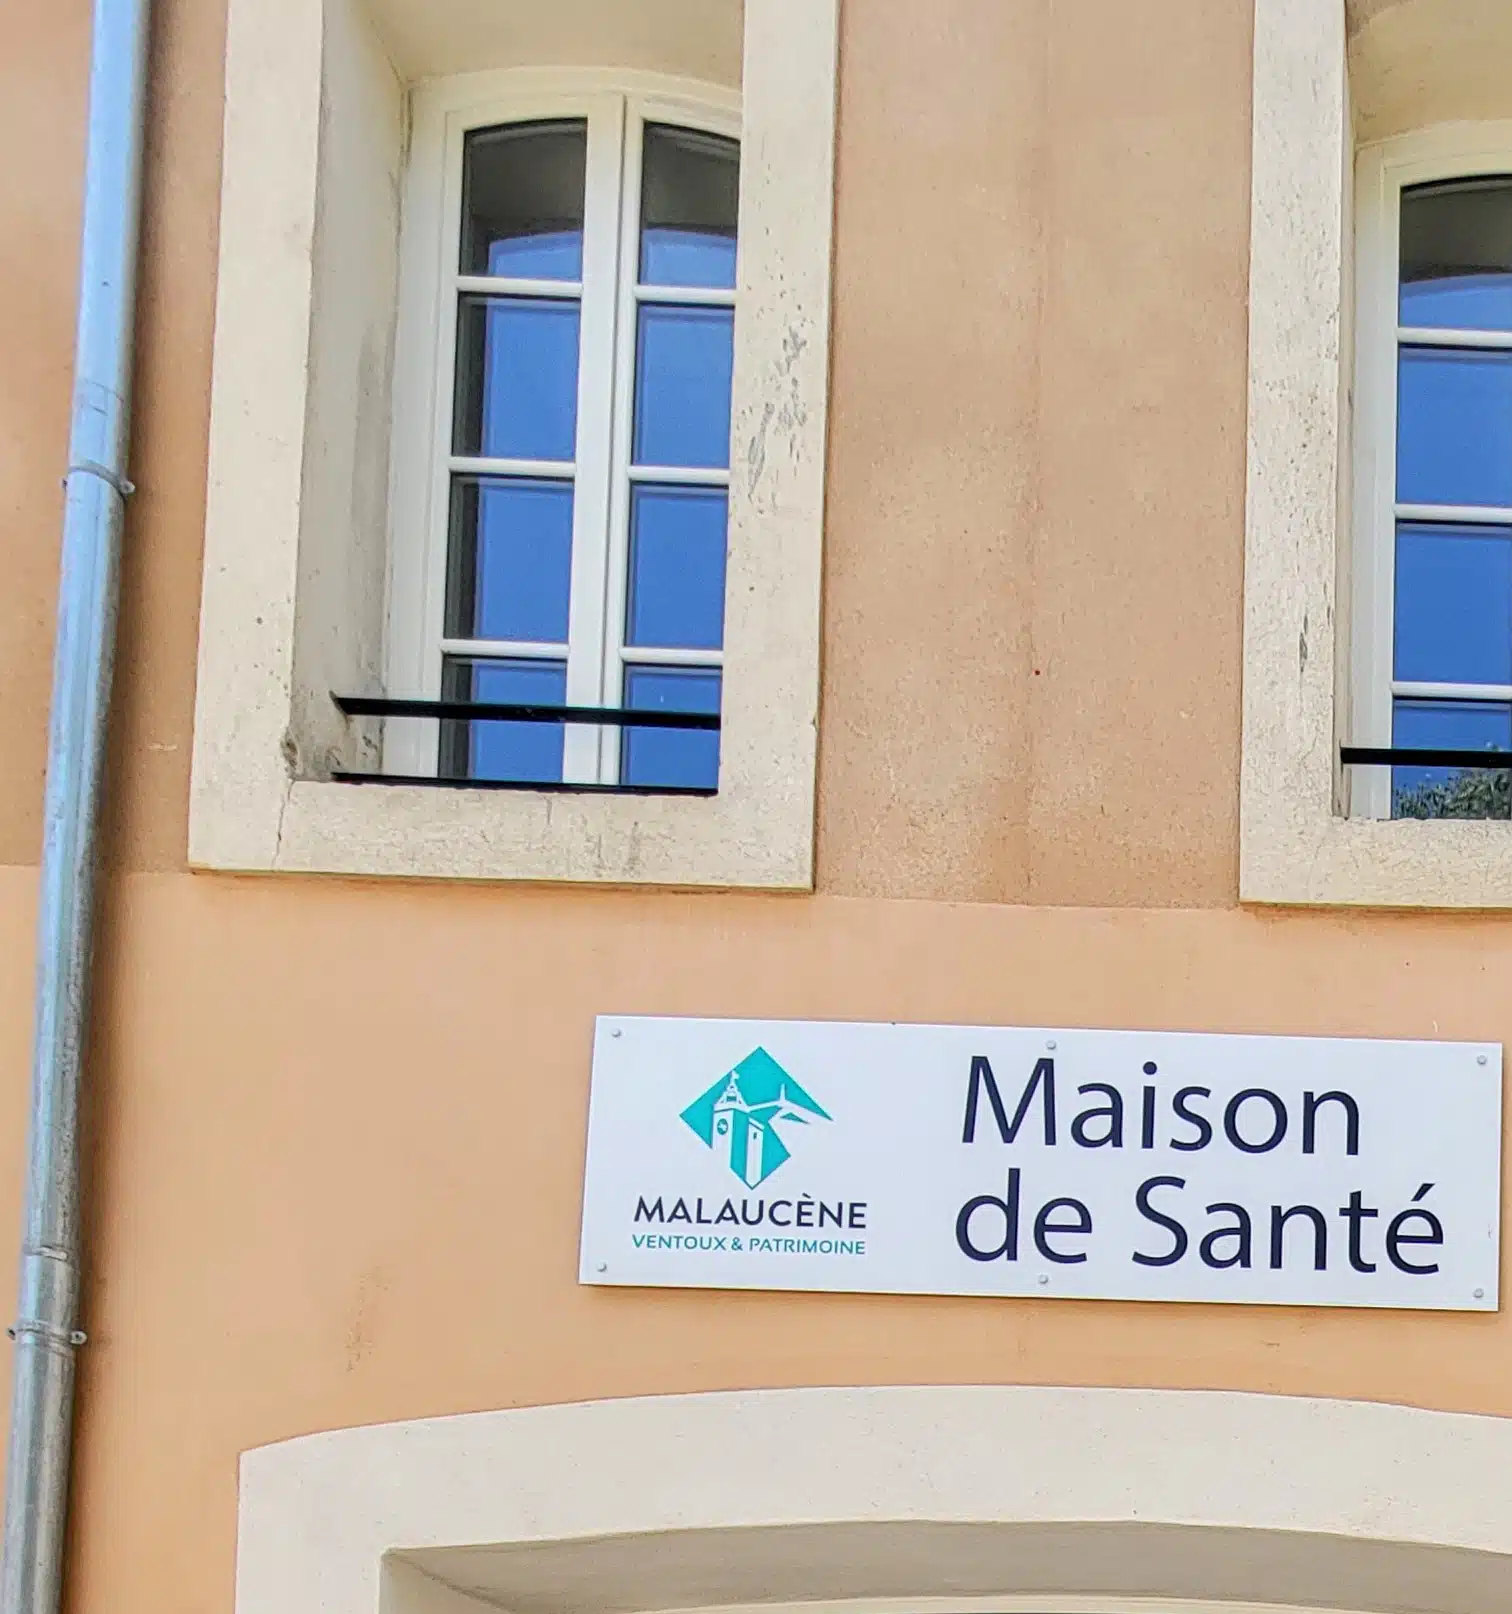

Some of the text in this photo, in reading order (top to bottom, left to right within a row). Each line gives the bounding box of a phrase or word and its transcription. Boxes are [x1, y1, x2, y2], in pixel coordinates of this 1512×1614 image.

[961, 1055, 1360, 1156] Maison
[632, 1234, 866, 1255] VENTOUX & PATRIMOINE
[633, 1192, 868, 1229] MALAUCÈNE
[955, 1167, 1444, 1275] de Santé
